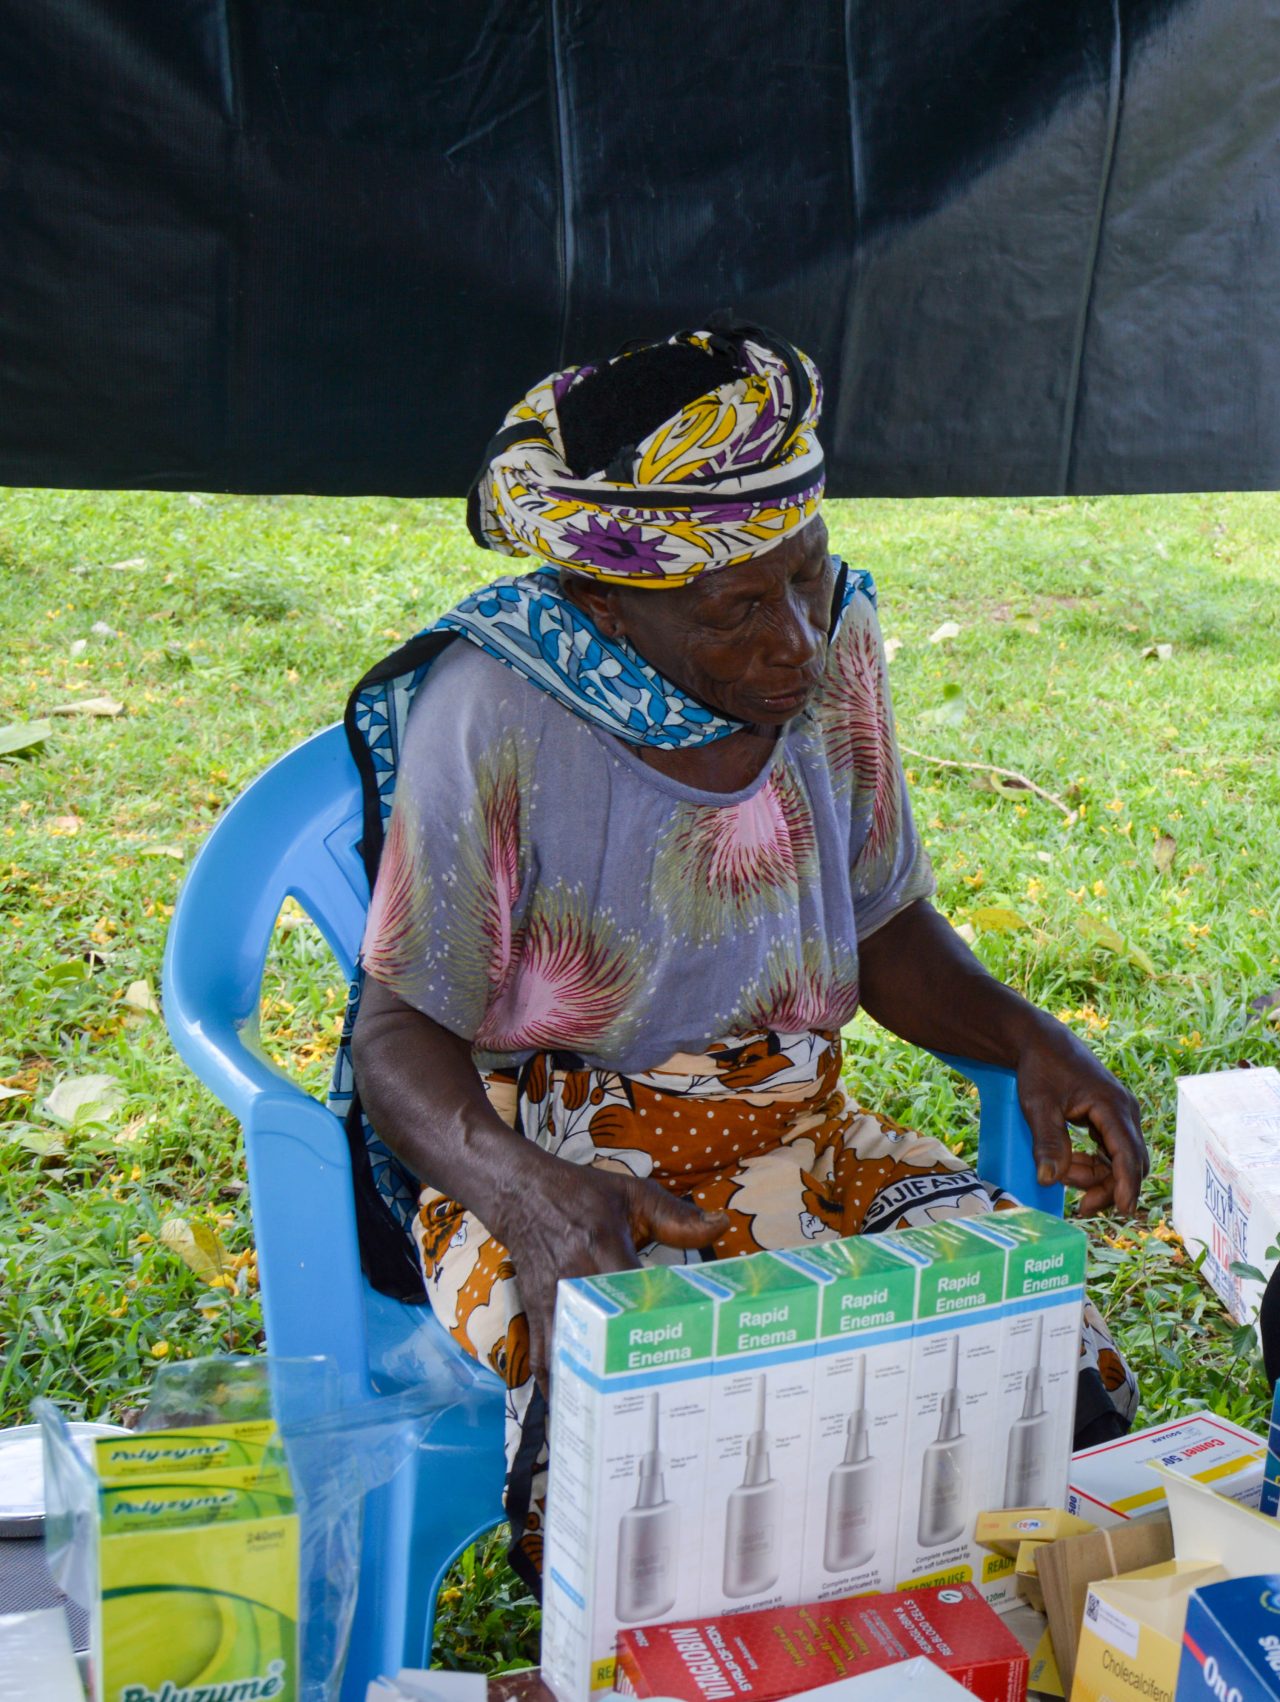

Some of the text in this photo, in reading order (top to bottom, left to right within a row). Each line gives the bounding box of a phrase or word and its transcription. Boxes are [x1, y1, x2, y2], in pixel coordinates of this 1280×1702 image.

[1024, 1253, 1064, 1275] Rapid
[937, 1271, 980, 1293] Rapid
[1022, 1274, 1069, 1295] Enema
[841, 1288, 888, 1312] Rapid
[935, 1292, 986, 1313] Enema
[739, 1306, 789, 1332] Rapid
[839, 1310, 895, 1332] Enema
[628, 1323, 683, 1347] Rapid
[738, 1328, 797, 1350] Enema
[628, 1346, 692, 1369] Enema
[1151, 1430, 1182, 1444] SQUARE
[1183, 1438, 1225, 1459] Comet
[911, 1565, 923, 1574] with
[924, 1561, 935, 1570] soft
[935, 1554, 962, 1567] lubricated
[915, 1552, 941, 1564] Complete
[942, 1547, 961, 1557] enema
[821, 1569, 880, 1591] Complete enema kit
[947, 1571, 966, 1583] USE
[817, 1577, 882, 1600] with soft lubricated tip
[721, 1595, 783, 1618] Complete enema kit
[896, 1612, 936, 1655] HEMOGLOBIN
[901, 1598, 955, 1656] RED BLOOD CELLS
[703, 1624, 754, 1692] SYRUP OF IRON
